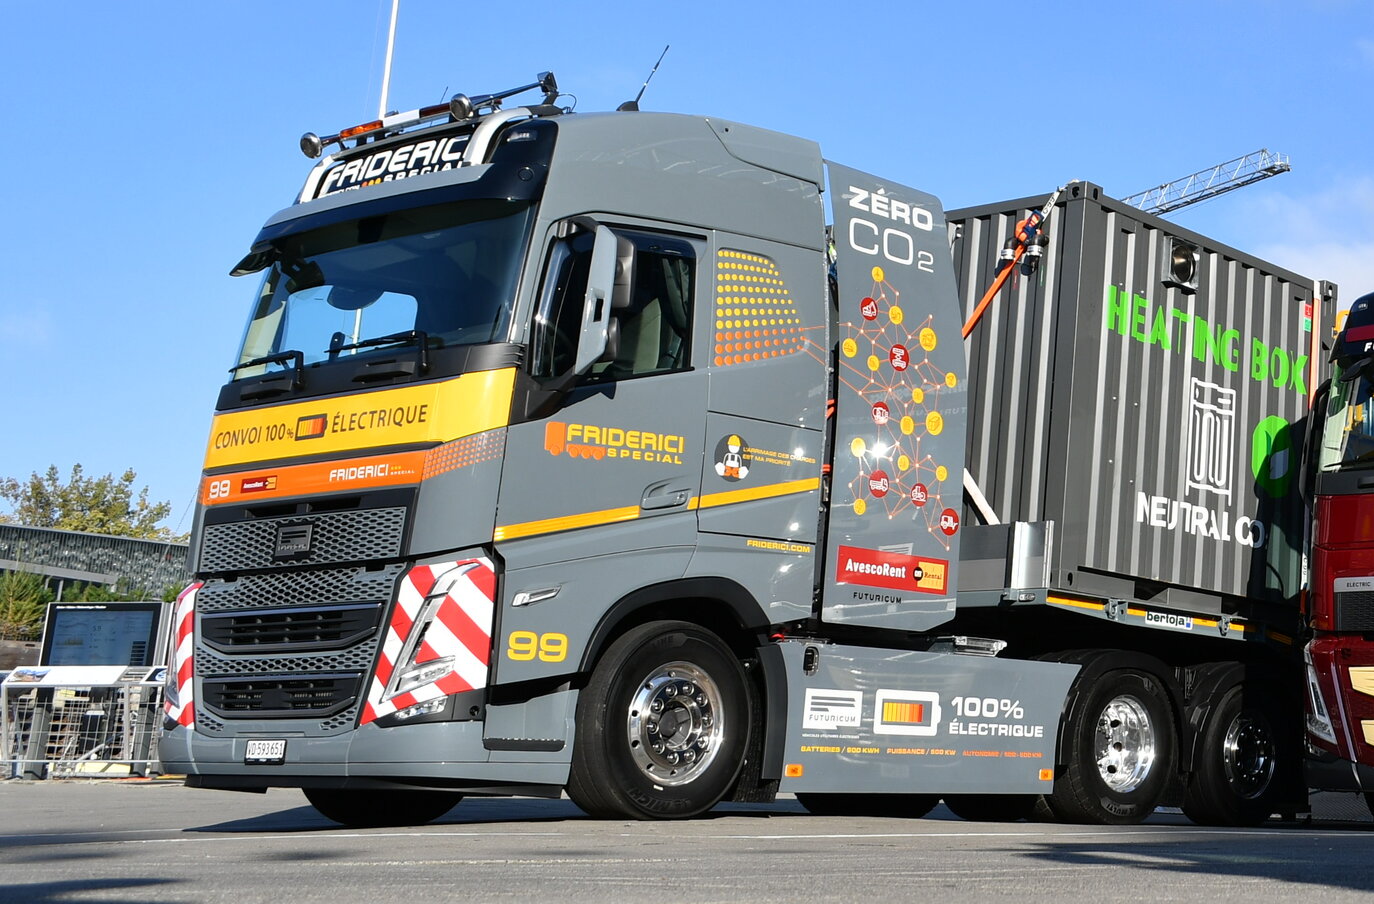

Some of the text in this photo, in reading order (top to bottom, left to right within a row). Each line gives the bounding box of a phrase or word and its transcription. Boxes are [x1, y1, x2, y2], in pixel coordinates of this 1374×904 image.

[322, 134, 471, 190] FRIDERIC
[849, 185, 933, 231] ZÉRO
[1107, 284, 1309, 395] HEATING BOX
[215, 426, 263, 450] CONVOI
[331, 404, 428, 434] ÉLECTRIQUE
[566, 423, 685, 454] FRIDERICI
[607, 447, 682, 465] SPECIAL
[329, 463, 390, 483] FRIDERICI
[208, 479, 231, 500] 99
[1136, 491, 1265, 549] NEUTRAL CO
[746, 539, 811, 553] FRIDERICI.COM
[845, 558, 906, 579] AvescoRent
[853, 592, 902, 605] FUTURICUM
[1146, 612, 1185, 627] bertoja
[507, 630, 568, 663] 99
[951, 696, 1024, 719] 100%
[809, 714, 856, 723] FUTURICUM
[949, 718, 1044, 738] ÉLECTRIQUE
